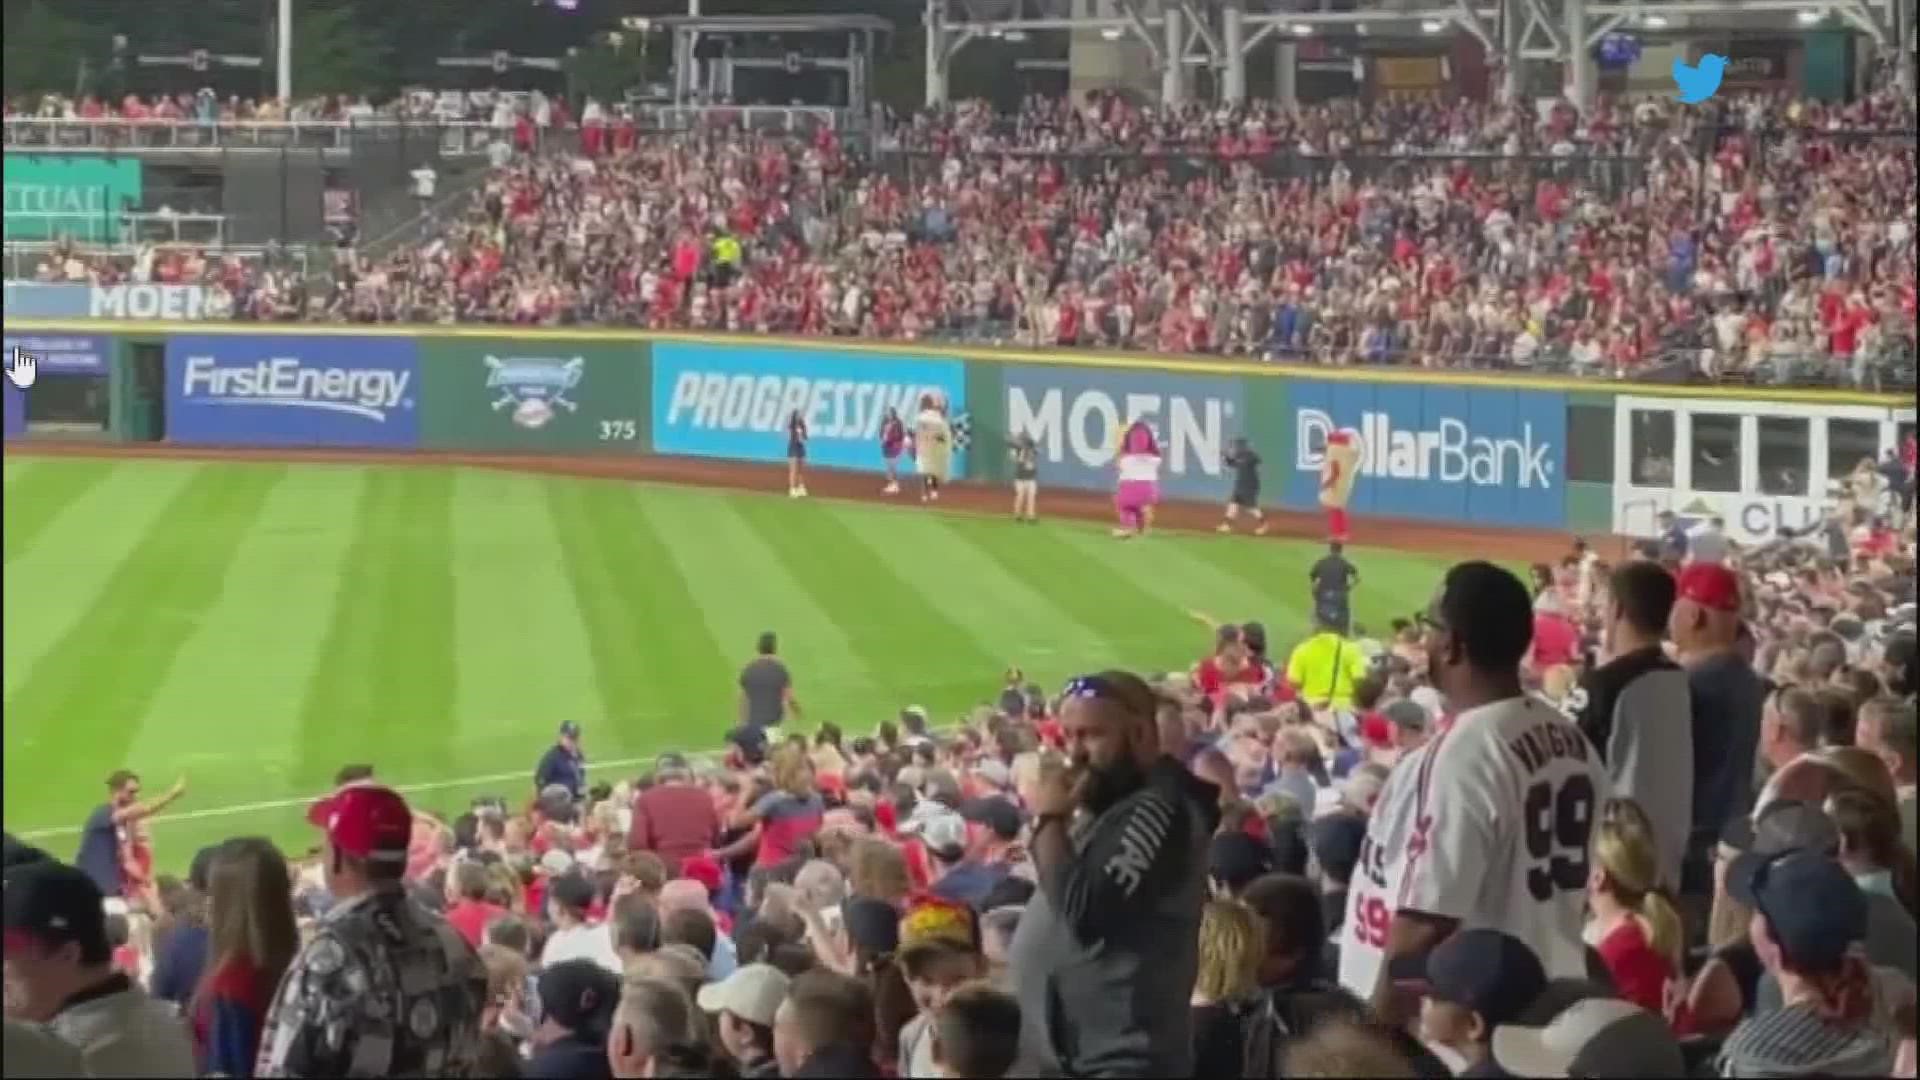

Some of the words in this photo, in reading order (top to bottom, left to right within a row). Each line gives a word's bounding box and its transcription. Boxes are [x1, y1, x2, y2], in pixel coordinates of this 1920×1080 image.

[183, 356, 410, 407] FirstEnergy
[599, 420, 637, 440] 375
[1296, 409, 1551, 489] DllarBank
[1525, 773, 1595, 902] 99
